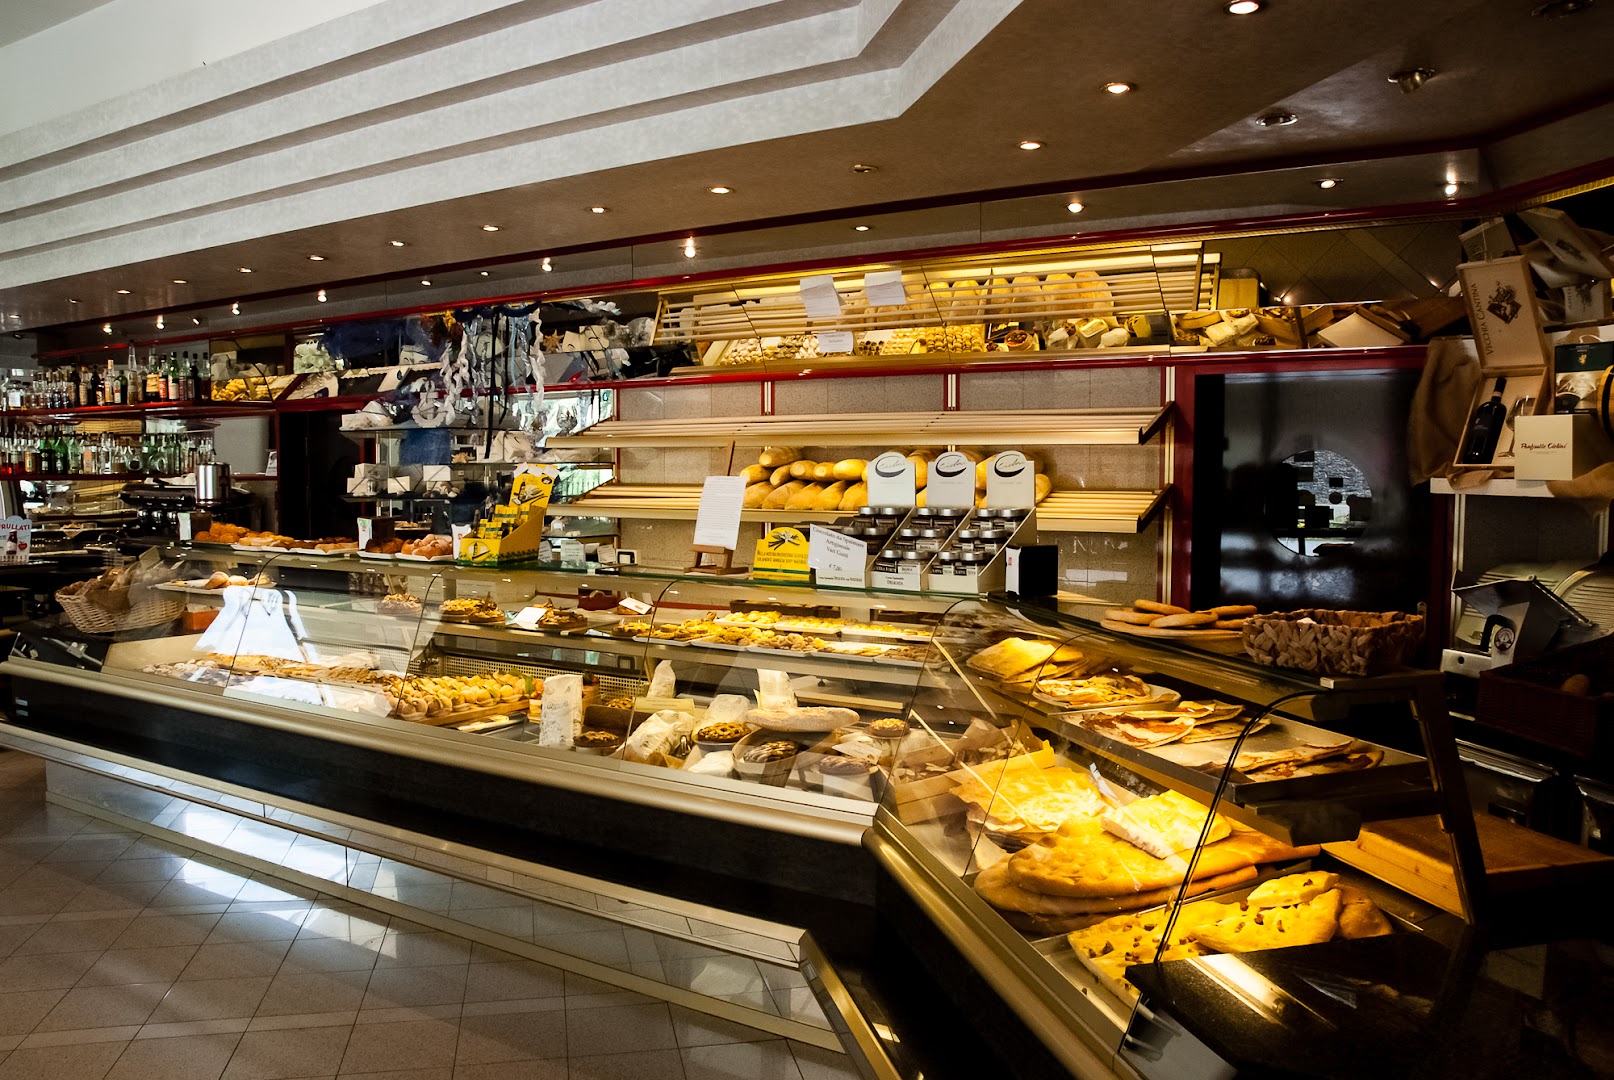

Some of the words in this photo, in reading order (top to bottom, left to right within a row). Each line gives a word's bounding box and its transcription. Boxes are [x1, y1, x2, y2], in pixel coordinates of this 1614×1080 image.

[1470, 283, 1486, 320] CANTINA
[1480, 322, 1494, 356] VECCHIA
[0, 523, 30, 531] RULLATI
